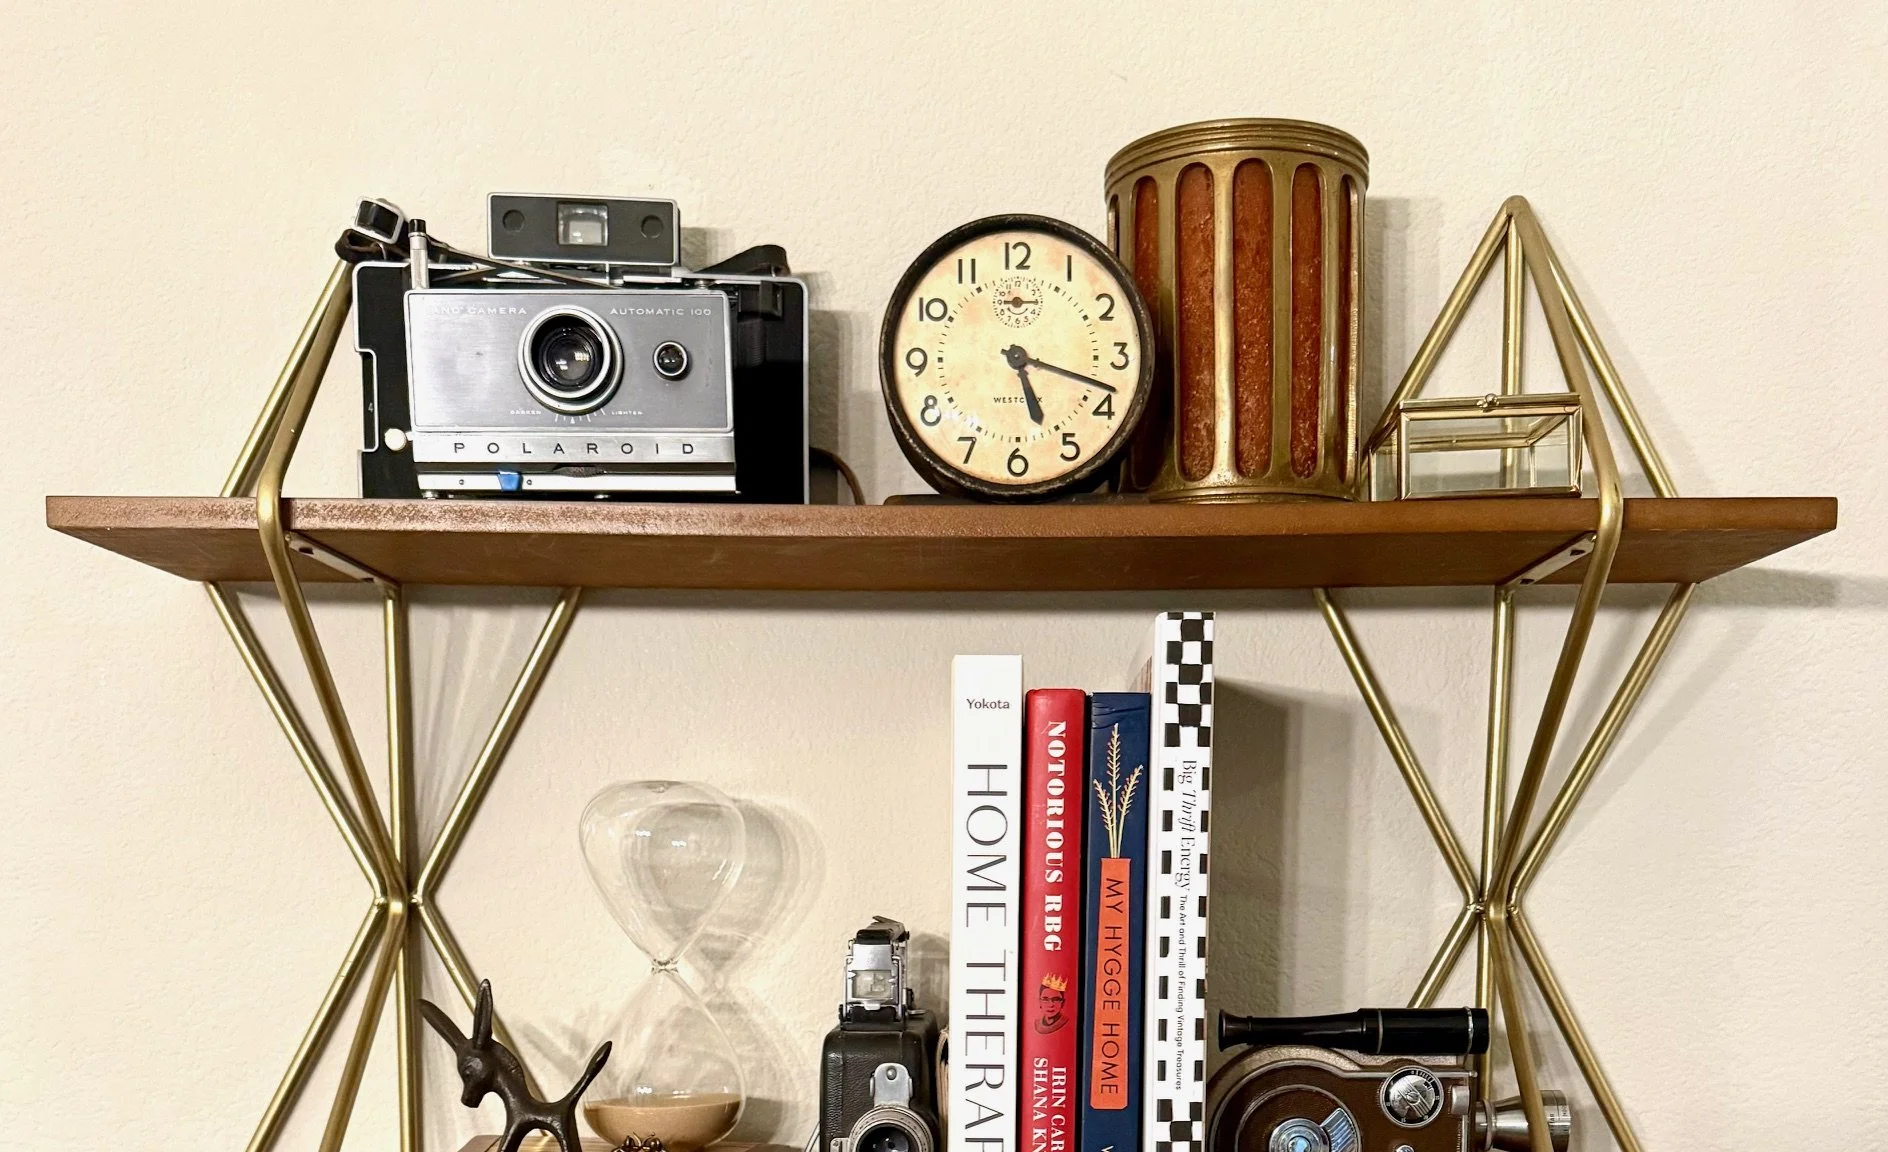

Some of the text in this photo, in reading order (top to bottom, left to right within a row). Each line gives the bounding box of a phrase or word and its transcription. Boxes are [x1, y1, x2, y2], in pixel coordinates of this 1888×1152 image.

[1005, 242, 1031, 270] 12
[1066, 255, 1072, 282] 1
[958, 258, 976, 284] 11
[467, 307, 528, 315] CAMERA
[610, 308, 685, 316] AUTOMATIC
[919, 297, 948, 322] 10
[1095, 293, 1115, 321] 2
[906, 348, 928, 377] 9
[1110, 342, 1130, 370] 3
[368, 402, 374, 412] 4
[920, 395, 941, 426] 8
[1092, 393, 1115, 420] 4
[453, 442, 694, 455] POLAROID
[957, 436, 977, 464] 7
[1060, 433, 1081, 462] 5
[1008, 448, 1028, 477] 6
[966, 698, 1010, 710] Yokota
[1043, 720, 1067, 952] NOTORIOUS RBG
[1175, 760, 1196, 892] Big Thrift Energy
[966, 764, 1008, 927] HOME
[1180, 894, 1188, 911] The
[1100, 877, 1124, 1094] MY HYGGE HOME
[1179, 970, 1186, 980] of
[1176, 981, 1186, 1013] Finding
[1176, 1014, 1184, 1047] Vintage
[1176, 1049, 1184, 1090] Treasures
[1033, 1057, 1048, 1122] SHANA
[1050, 1066, 1066, 1109] IRIN
